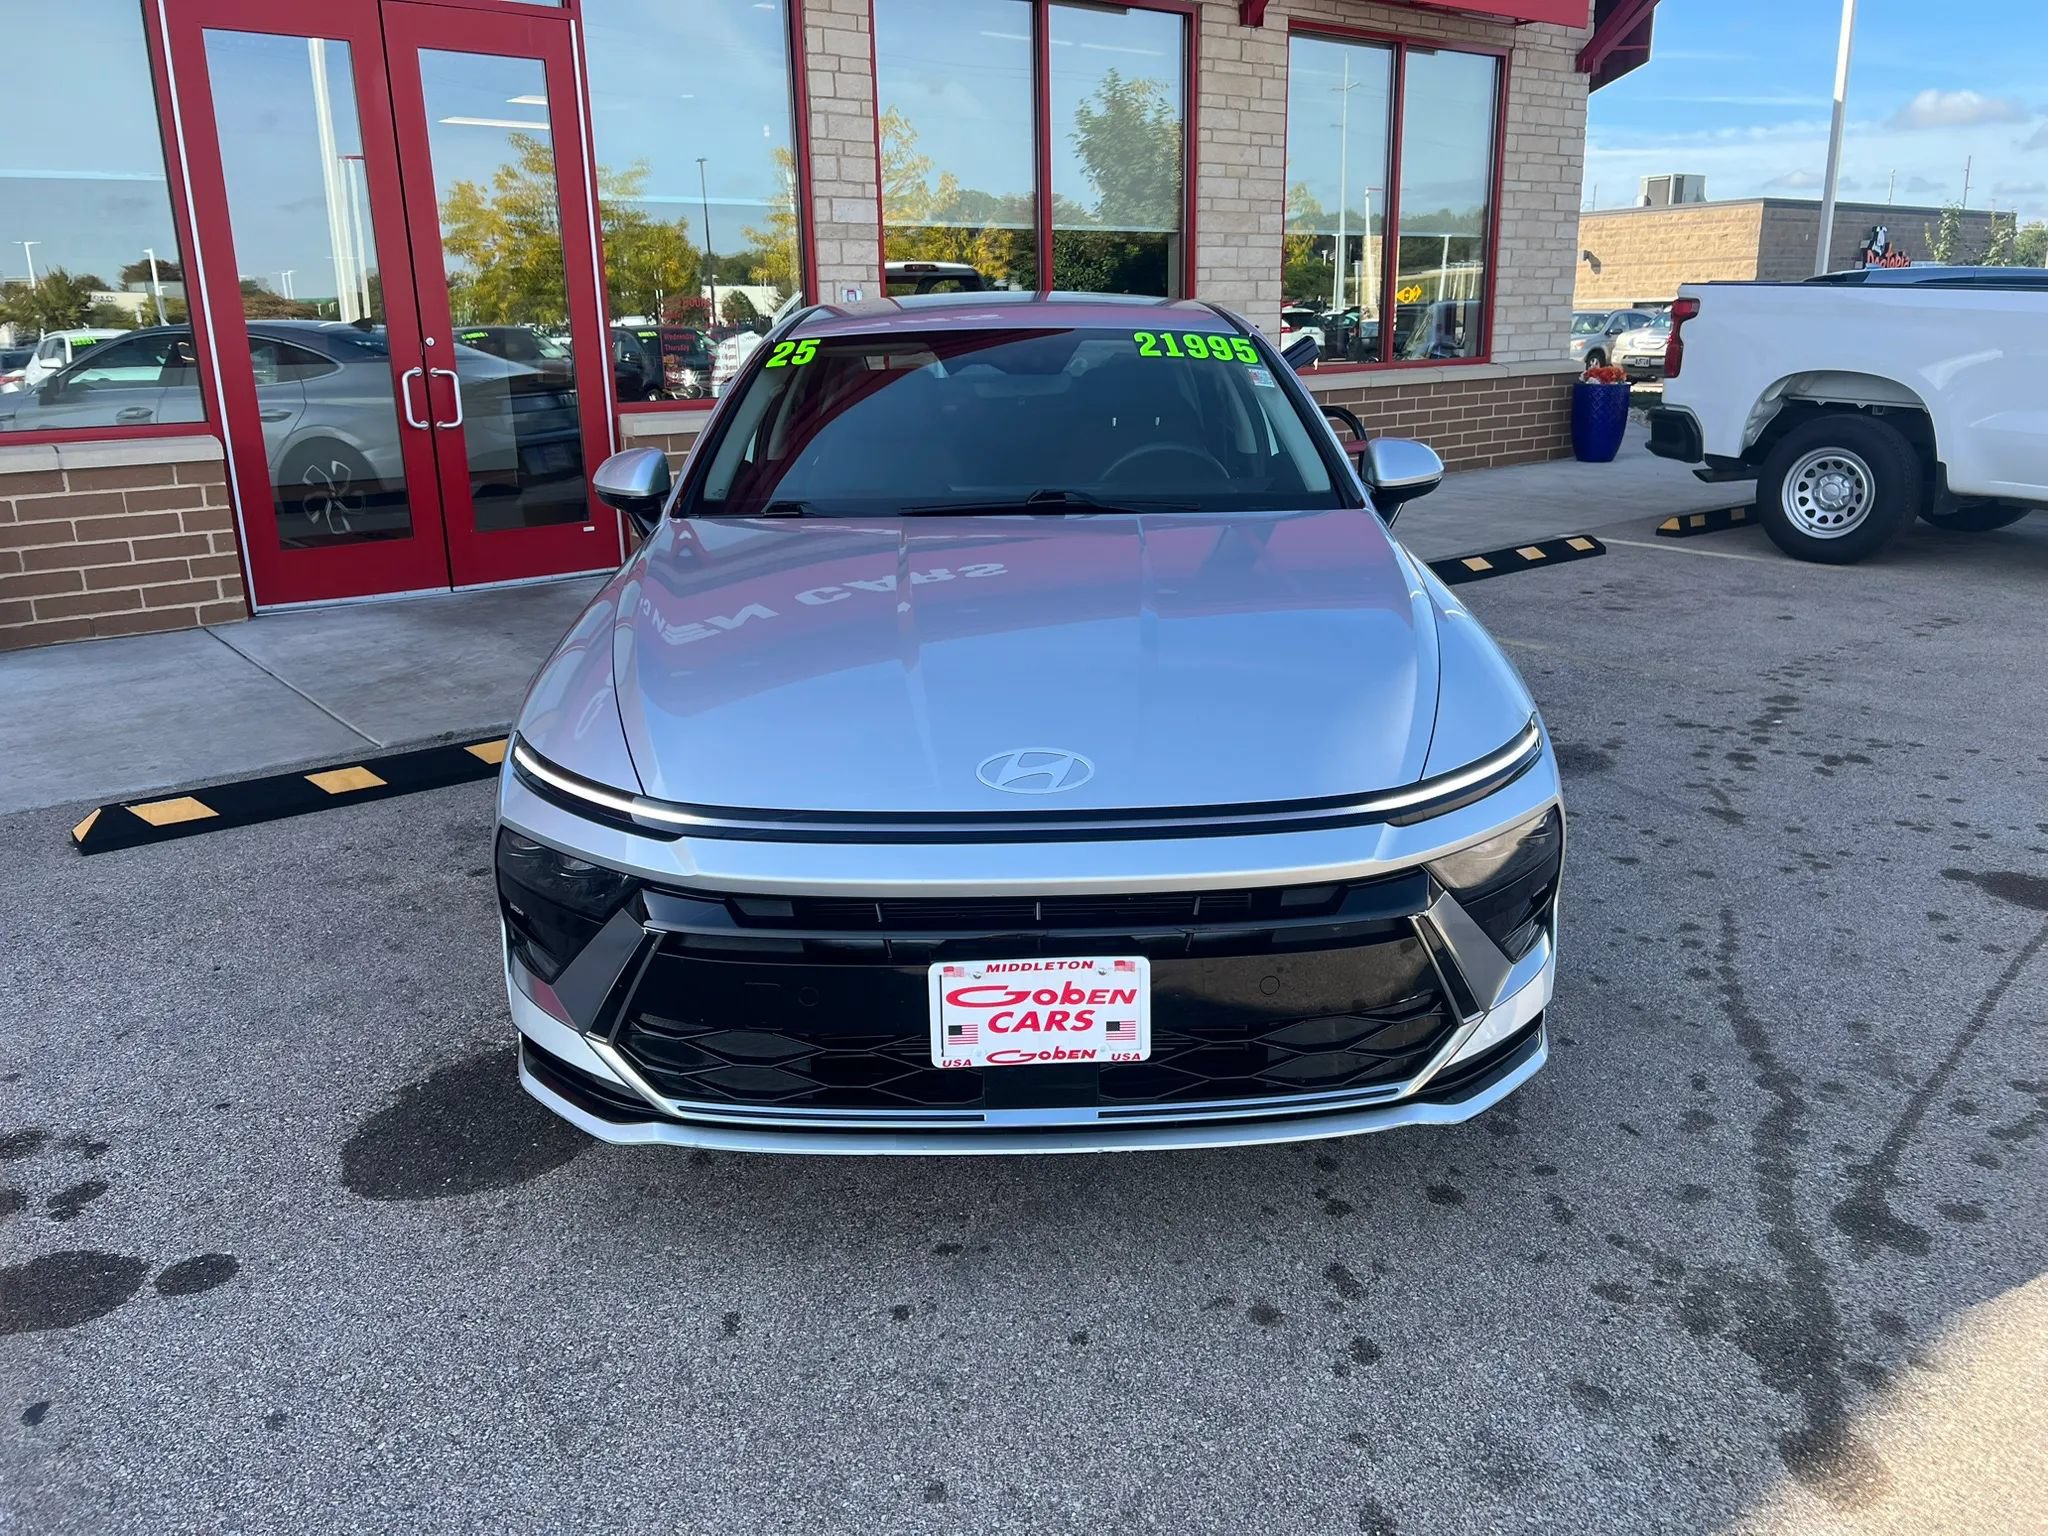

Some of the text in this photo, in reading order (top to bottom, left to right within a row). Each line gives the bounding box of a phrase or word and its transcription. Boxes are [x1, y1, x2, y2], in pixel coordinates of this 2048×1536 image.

[765, 339, 821, 368] 25
[1133, 332, 1260, 364] 21995
[986, 960, 1094, 973] MIDDLETON
[988, 1010, 1096, 1033] CARS
[942, 1059, 972, 1068] USA
[1111, 1053, 1141, 1061] USA
